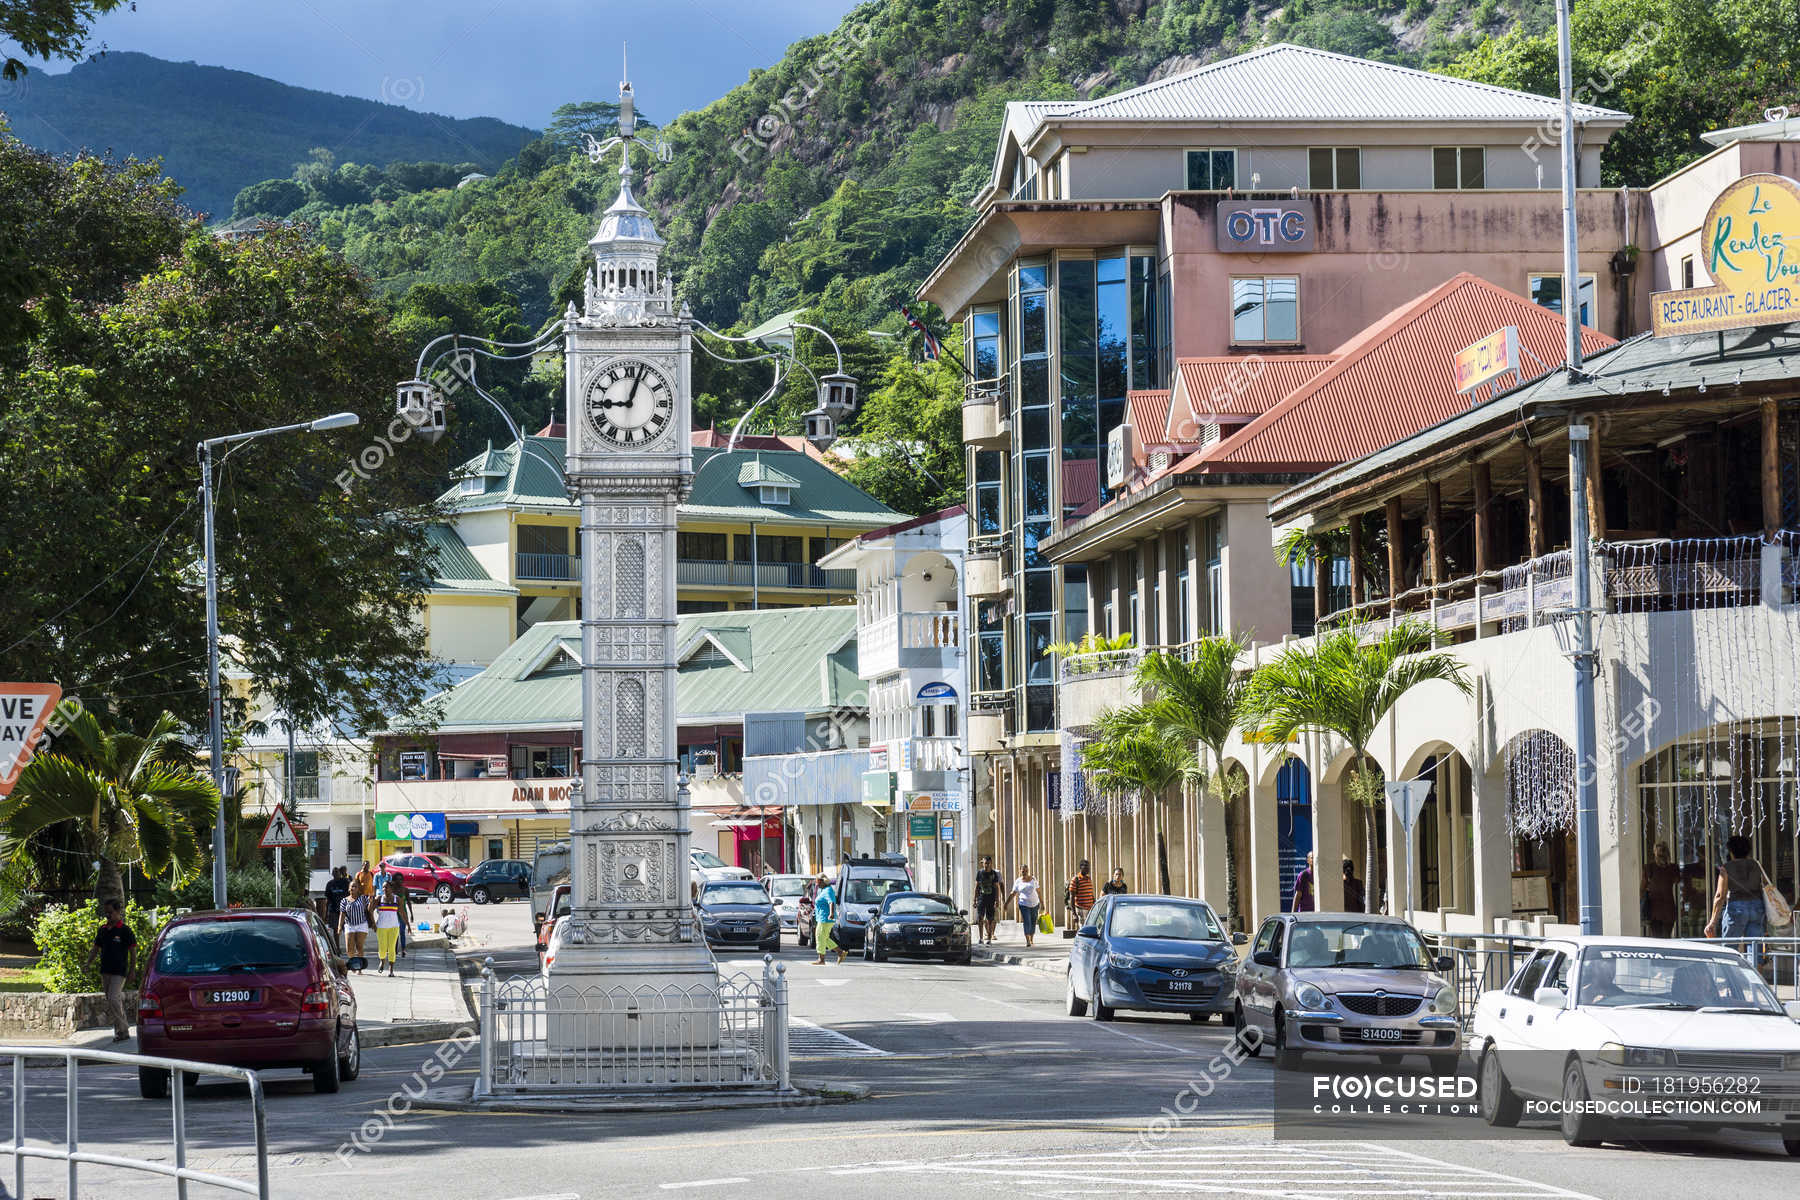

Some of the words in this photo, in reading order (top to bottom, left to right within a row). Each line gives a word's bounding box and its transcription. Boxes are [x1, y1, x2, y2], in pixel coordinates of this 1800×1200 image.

[1749, 185, 1773, 214] Le
[1227, 208, 1305, 245] OTC
[1711, 215, 1787, 273] Rendez
[1663, 295, 1735, 323] RESTAURANT
[1745, 288, 1791, 314] GLACIER
[608, 370, 619, 383] XI
[624, 366, 635, 378] XII
[596, 384, 608, 393] X
[653, 383, 664, 392] II
[606, 427, 617, 440] VII
[625, 430, 634, 442] VI
[642, 426, 651, 436] V
[512, 787, 543, 801] ADAM
[549, 786, 573, 801] MOO
[1613, 951, 1664, 960] TOYOTA
[1363, 1029, 1400, 1039] S14009
